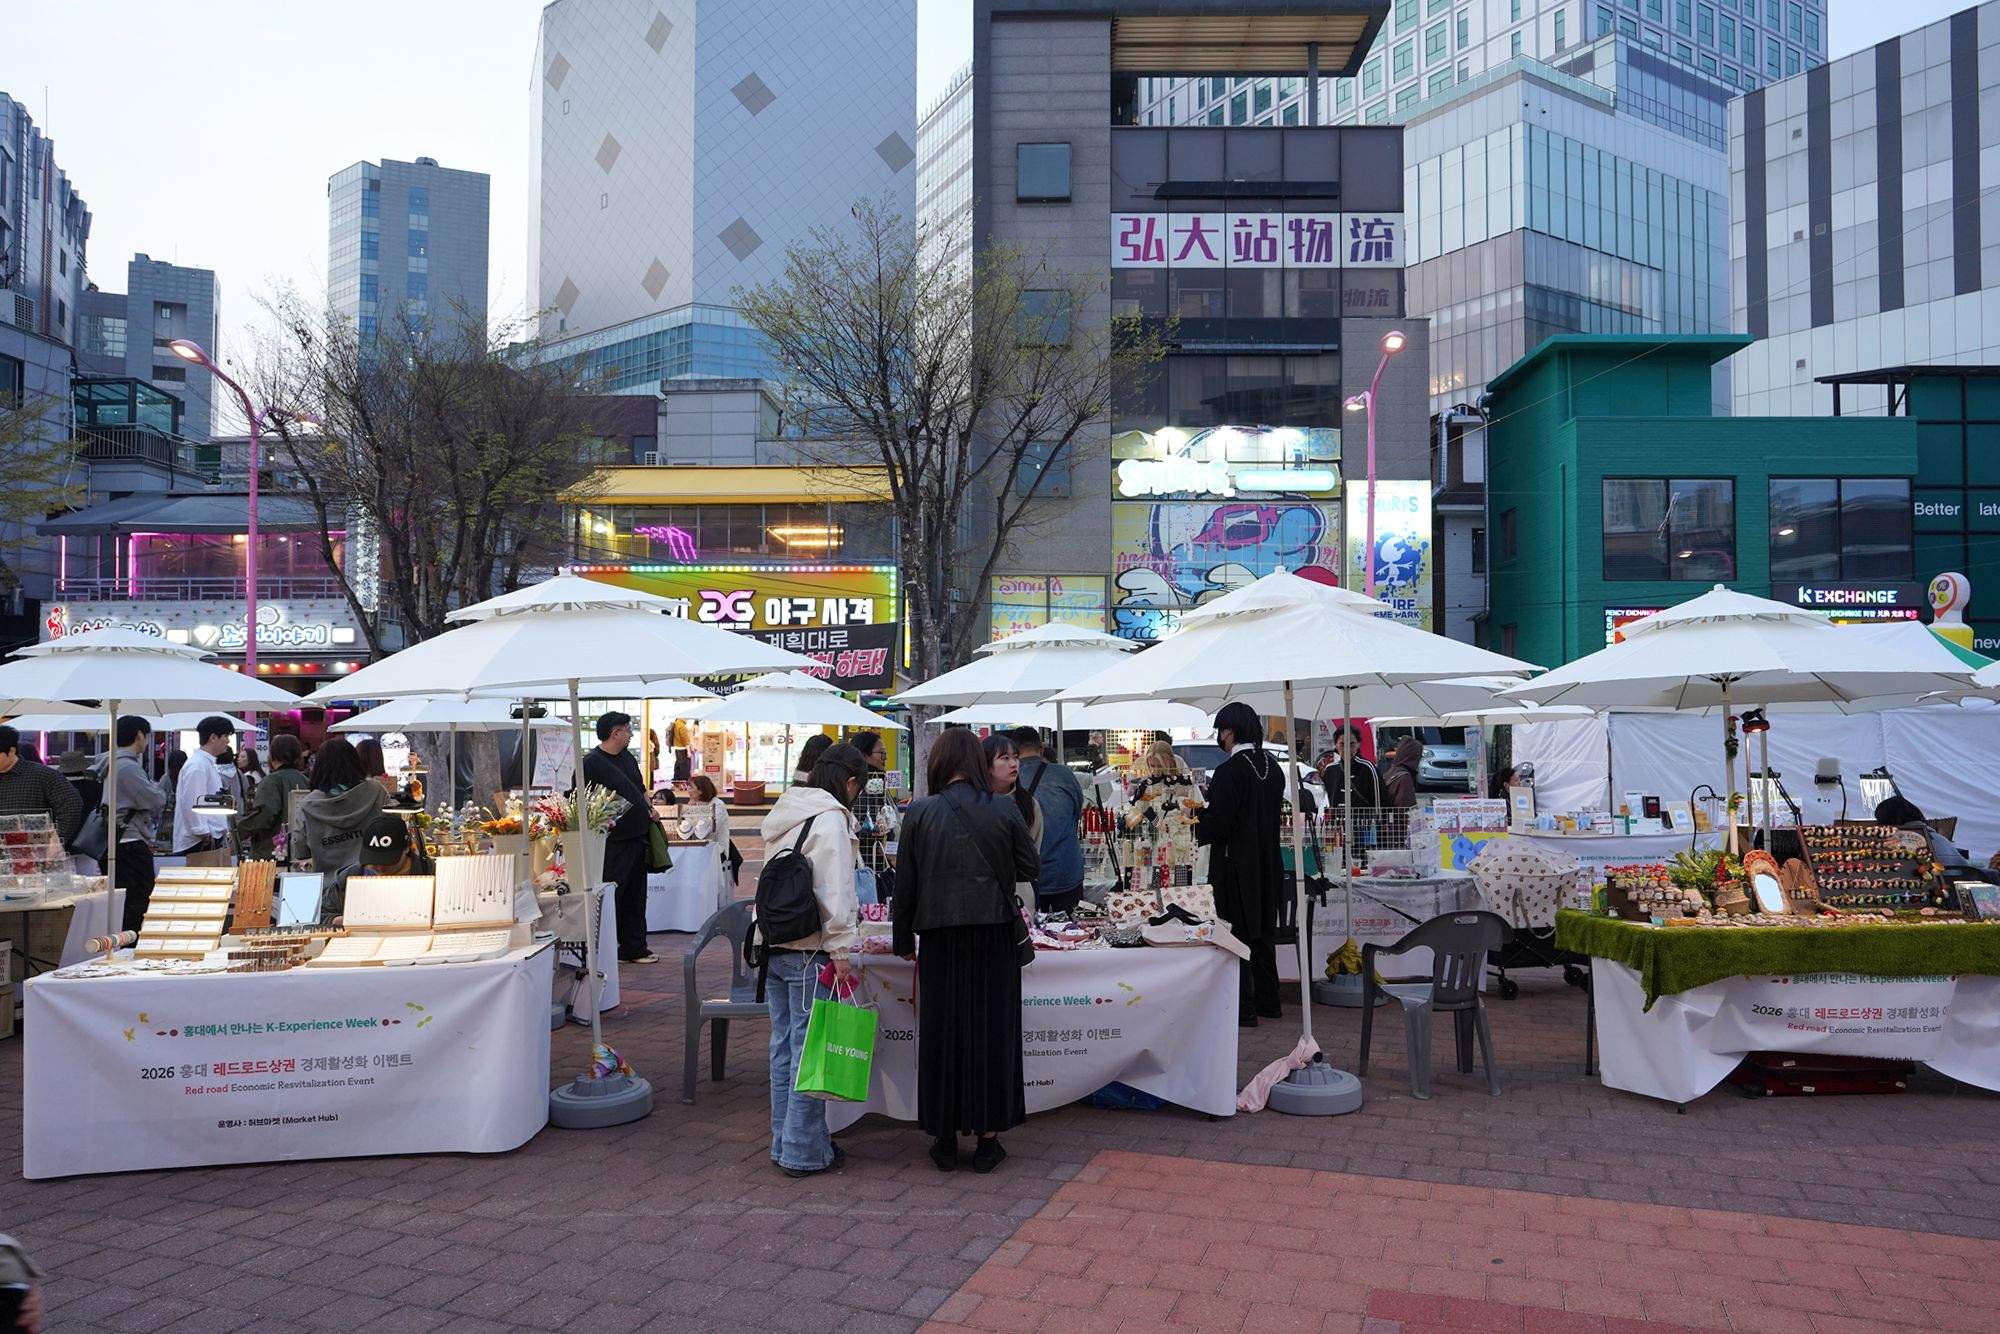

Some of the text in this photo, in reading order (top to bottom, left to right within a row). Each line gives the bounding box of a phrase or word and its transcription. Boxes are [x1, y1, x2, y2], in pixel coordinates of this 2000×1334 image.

[1120, 217, 1394, 263] 弘大站物流
[1914, 502, 1960, 516] Better
[1814, 590, 1898, 604] EXCHANGE
[765, 598, 874, 625] 야구 사격
[765, 630, 849, 651] 계획대로
[836, 648, 888, 678] 하라!
[1021, 995, 1092, 1006] erience Week
[1752, 1004, 1783, 1017] 2026
[1786, 1008, 1809, 1019] 홍대
[1815, 1007, 1883, 1020] 레드로드상권
[1887, 1006, 1939, 1019] 경제활성화
[184, 1017, 377, 1037] 홍대에서 만나는 K-Experience Week
[1787, 1021, 1804, 1031] Red
[1806, 1024, 1827, 1033] road
[1829, 1025, 1865, 1035] Economic
[1923, 1024, 1942, 1033] Event
[885, 1030, 914, 1041] 2026
[1023, 1028, 1122, 1043] 경제활성화 이벤트
[1064, 1047, 1088, 1057] Event
[141, 1053, 413, 1080] 2026 홍대 레드로드상권 경제활성화 이벤트
[185, 1085, 204, 1095] Red
[206, 1084, 229, 1094] road
[231, 1081, 276, 1092] Economic
[347, 1076, 375, 1087] Event
[218, 1120, 242, 1129] 운영사
[248, 1117, 281, 1127] 허브마켓
[282, 1115, 317, 1126] (Market
[318, 1114, 339, 1124] Hub)
